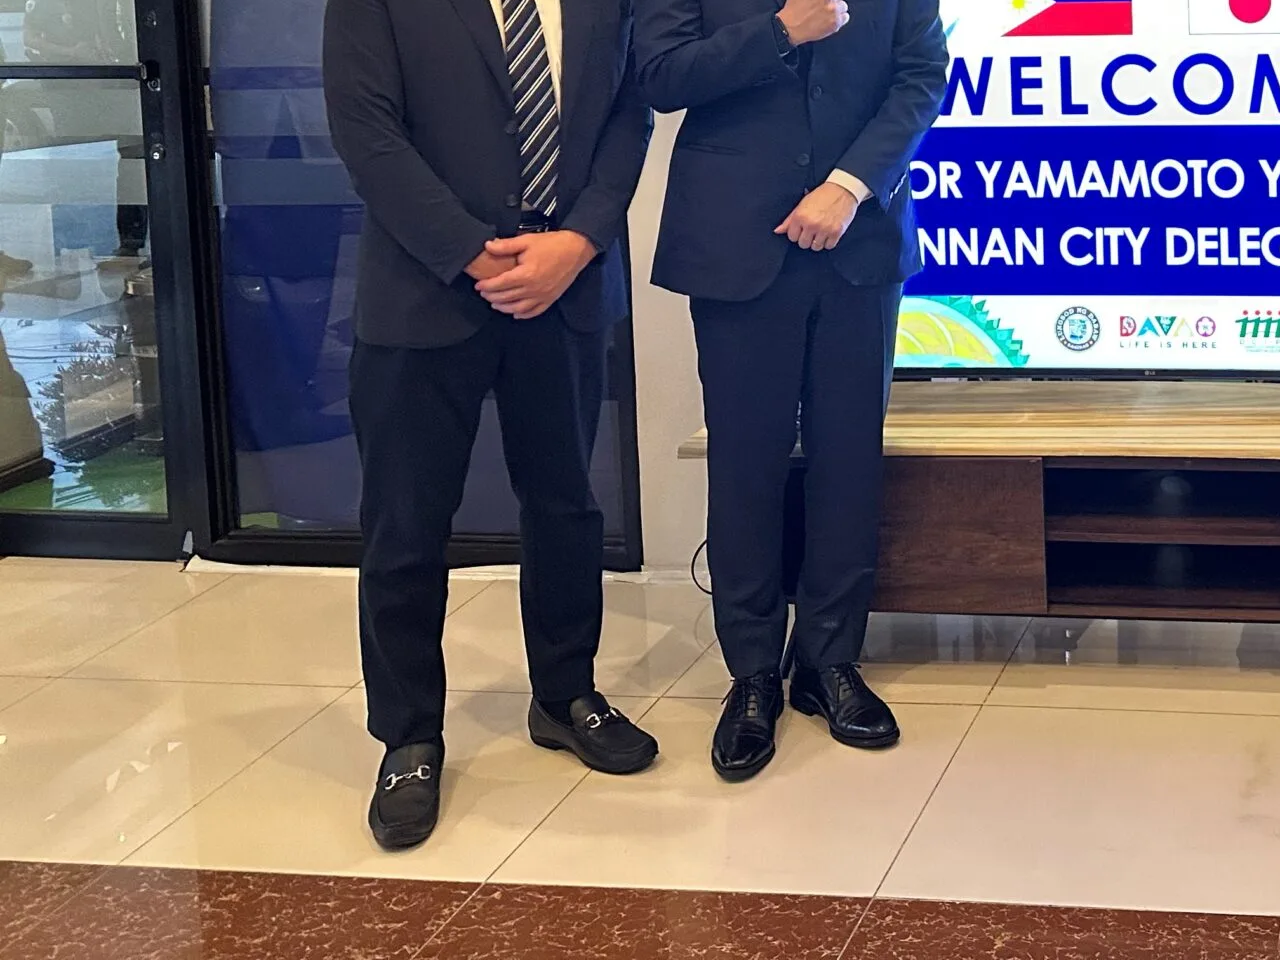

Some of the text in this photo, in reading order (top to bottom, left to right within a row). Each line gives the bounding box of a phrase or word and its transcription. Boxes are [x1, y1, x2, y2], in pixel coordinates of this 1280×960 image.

[975, 158, 1245, 199] YAMAMOTO
[917, 227, 1044, 266] NNAN
[1059, 226, 1150, 266] CITY
[1119, 316, 1217, 337] DAVAO
[1120, 341, 1217, 349] LIFE IS HERE
